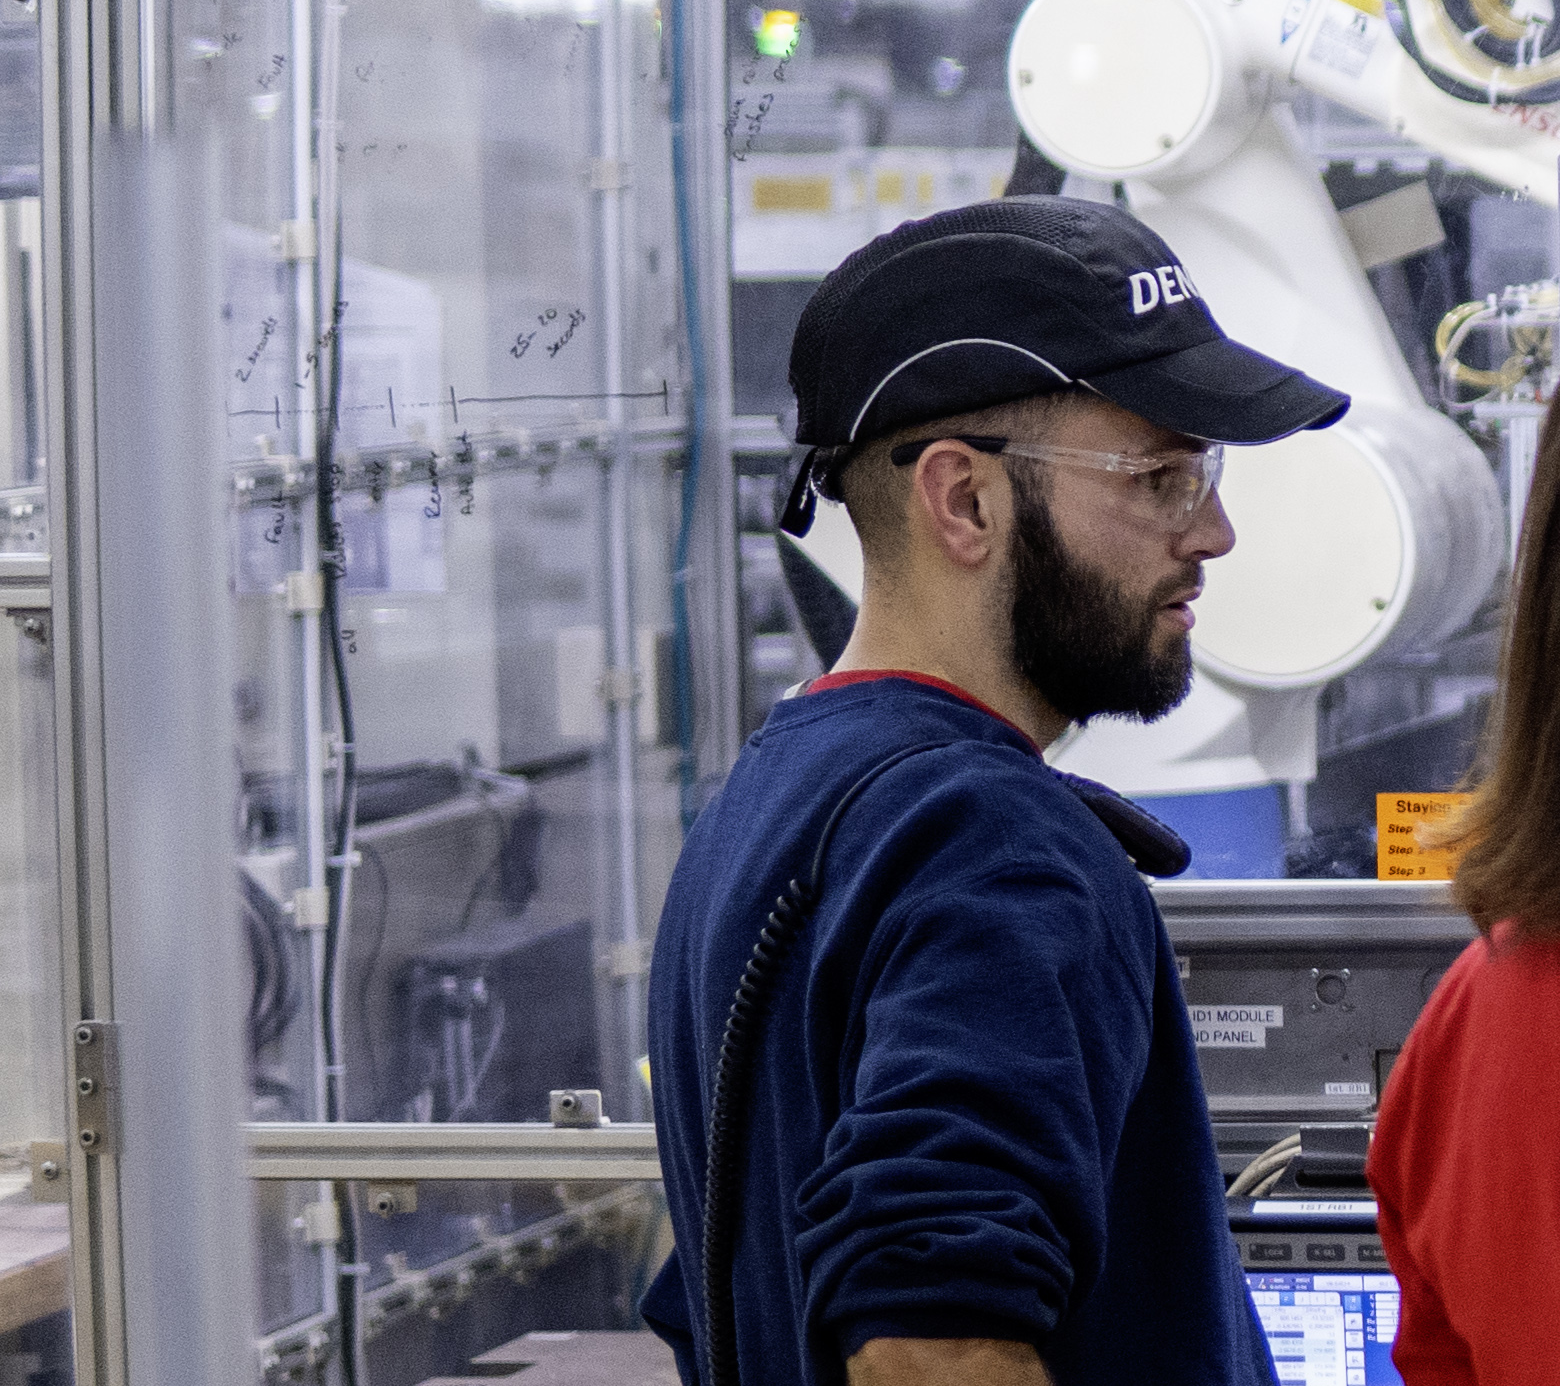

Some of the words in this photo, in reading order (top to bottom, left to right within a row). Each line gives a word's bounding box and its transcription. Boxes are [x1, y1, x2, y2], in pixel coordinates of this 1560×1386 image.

[1388, 824, 1413, 834] Step
[1388, 845, 1413, 855] Step
[1388, 866, 1413, 876] Step
[1418, 867, 1425, 876] 3
[1217, 1010, 1274, 1023] MODULE
[1214, 1031, 1256, 1042] PANEL
